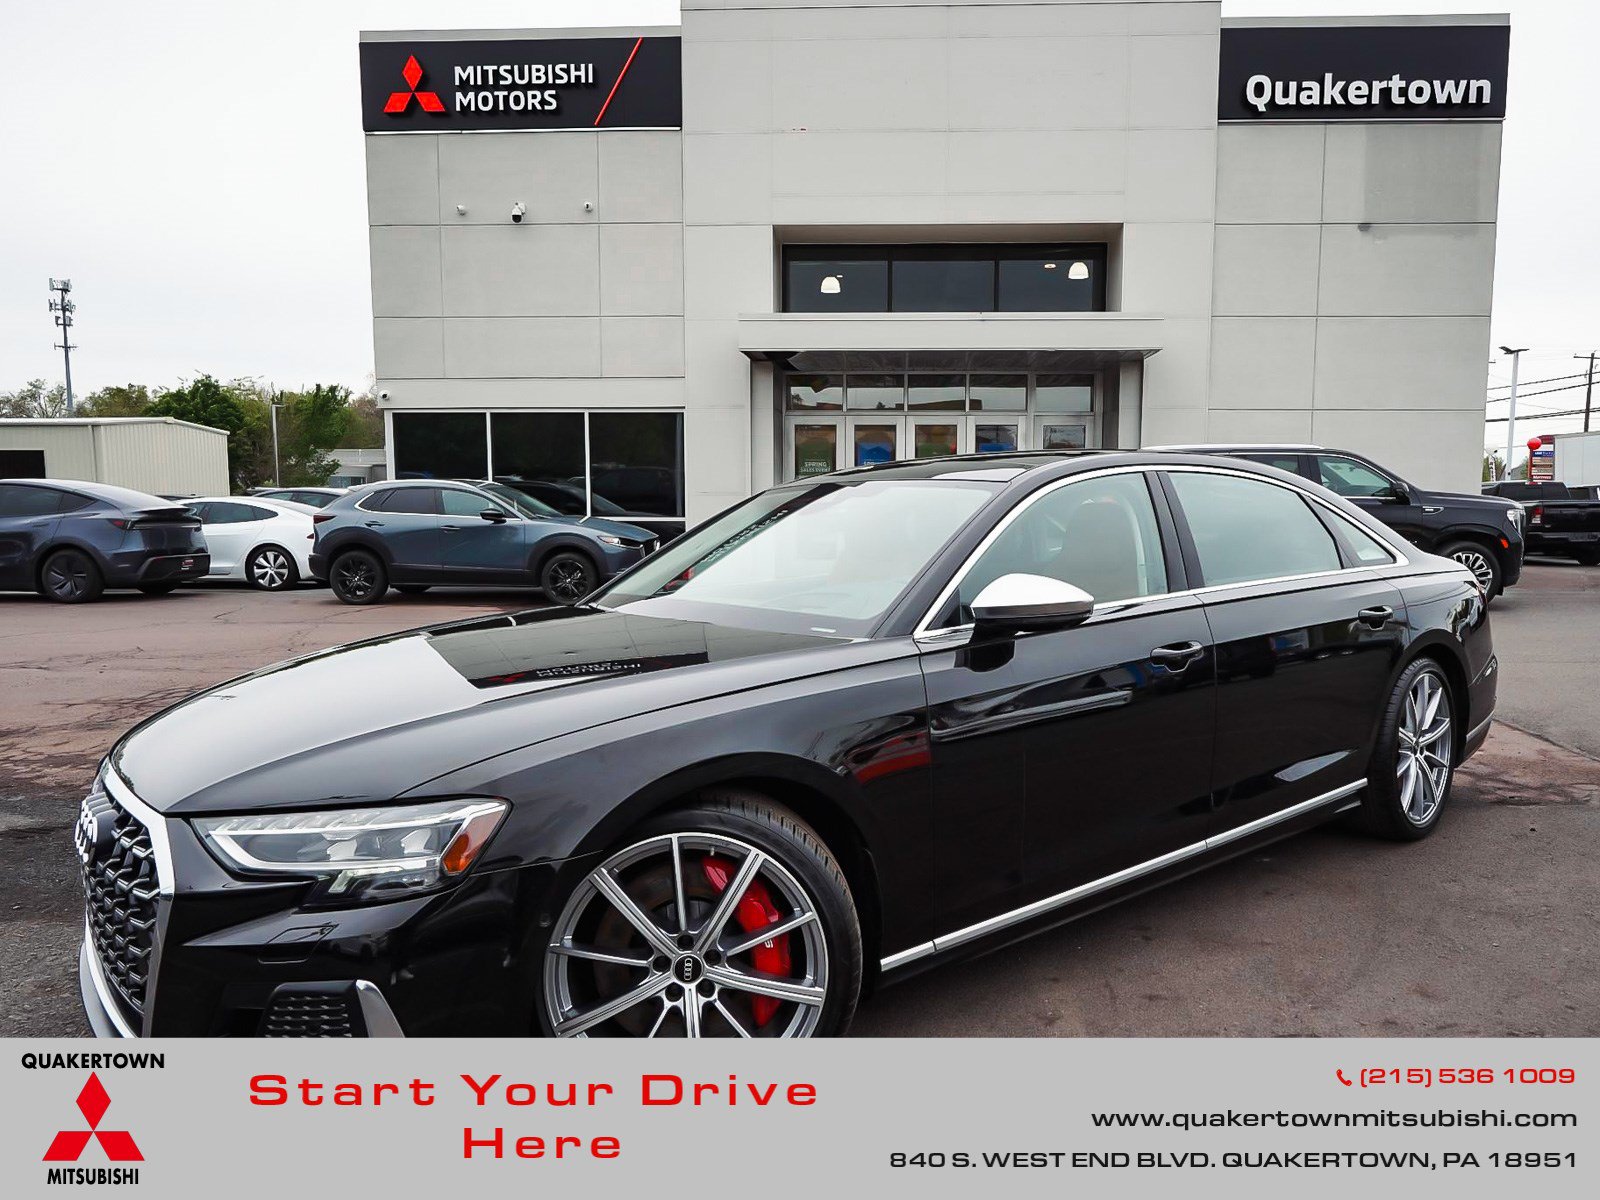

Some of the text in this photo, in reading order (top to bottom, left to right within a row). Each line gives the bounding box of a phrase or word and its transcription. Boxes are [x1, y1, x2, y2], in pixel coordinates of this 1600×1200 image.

[454, 63, 594, 87] MITSUBISHI
[455, 89, 558, 112] MOTORS
[1246, 73, 1491, 112] Quakertown
